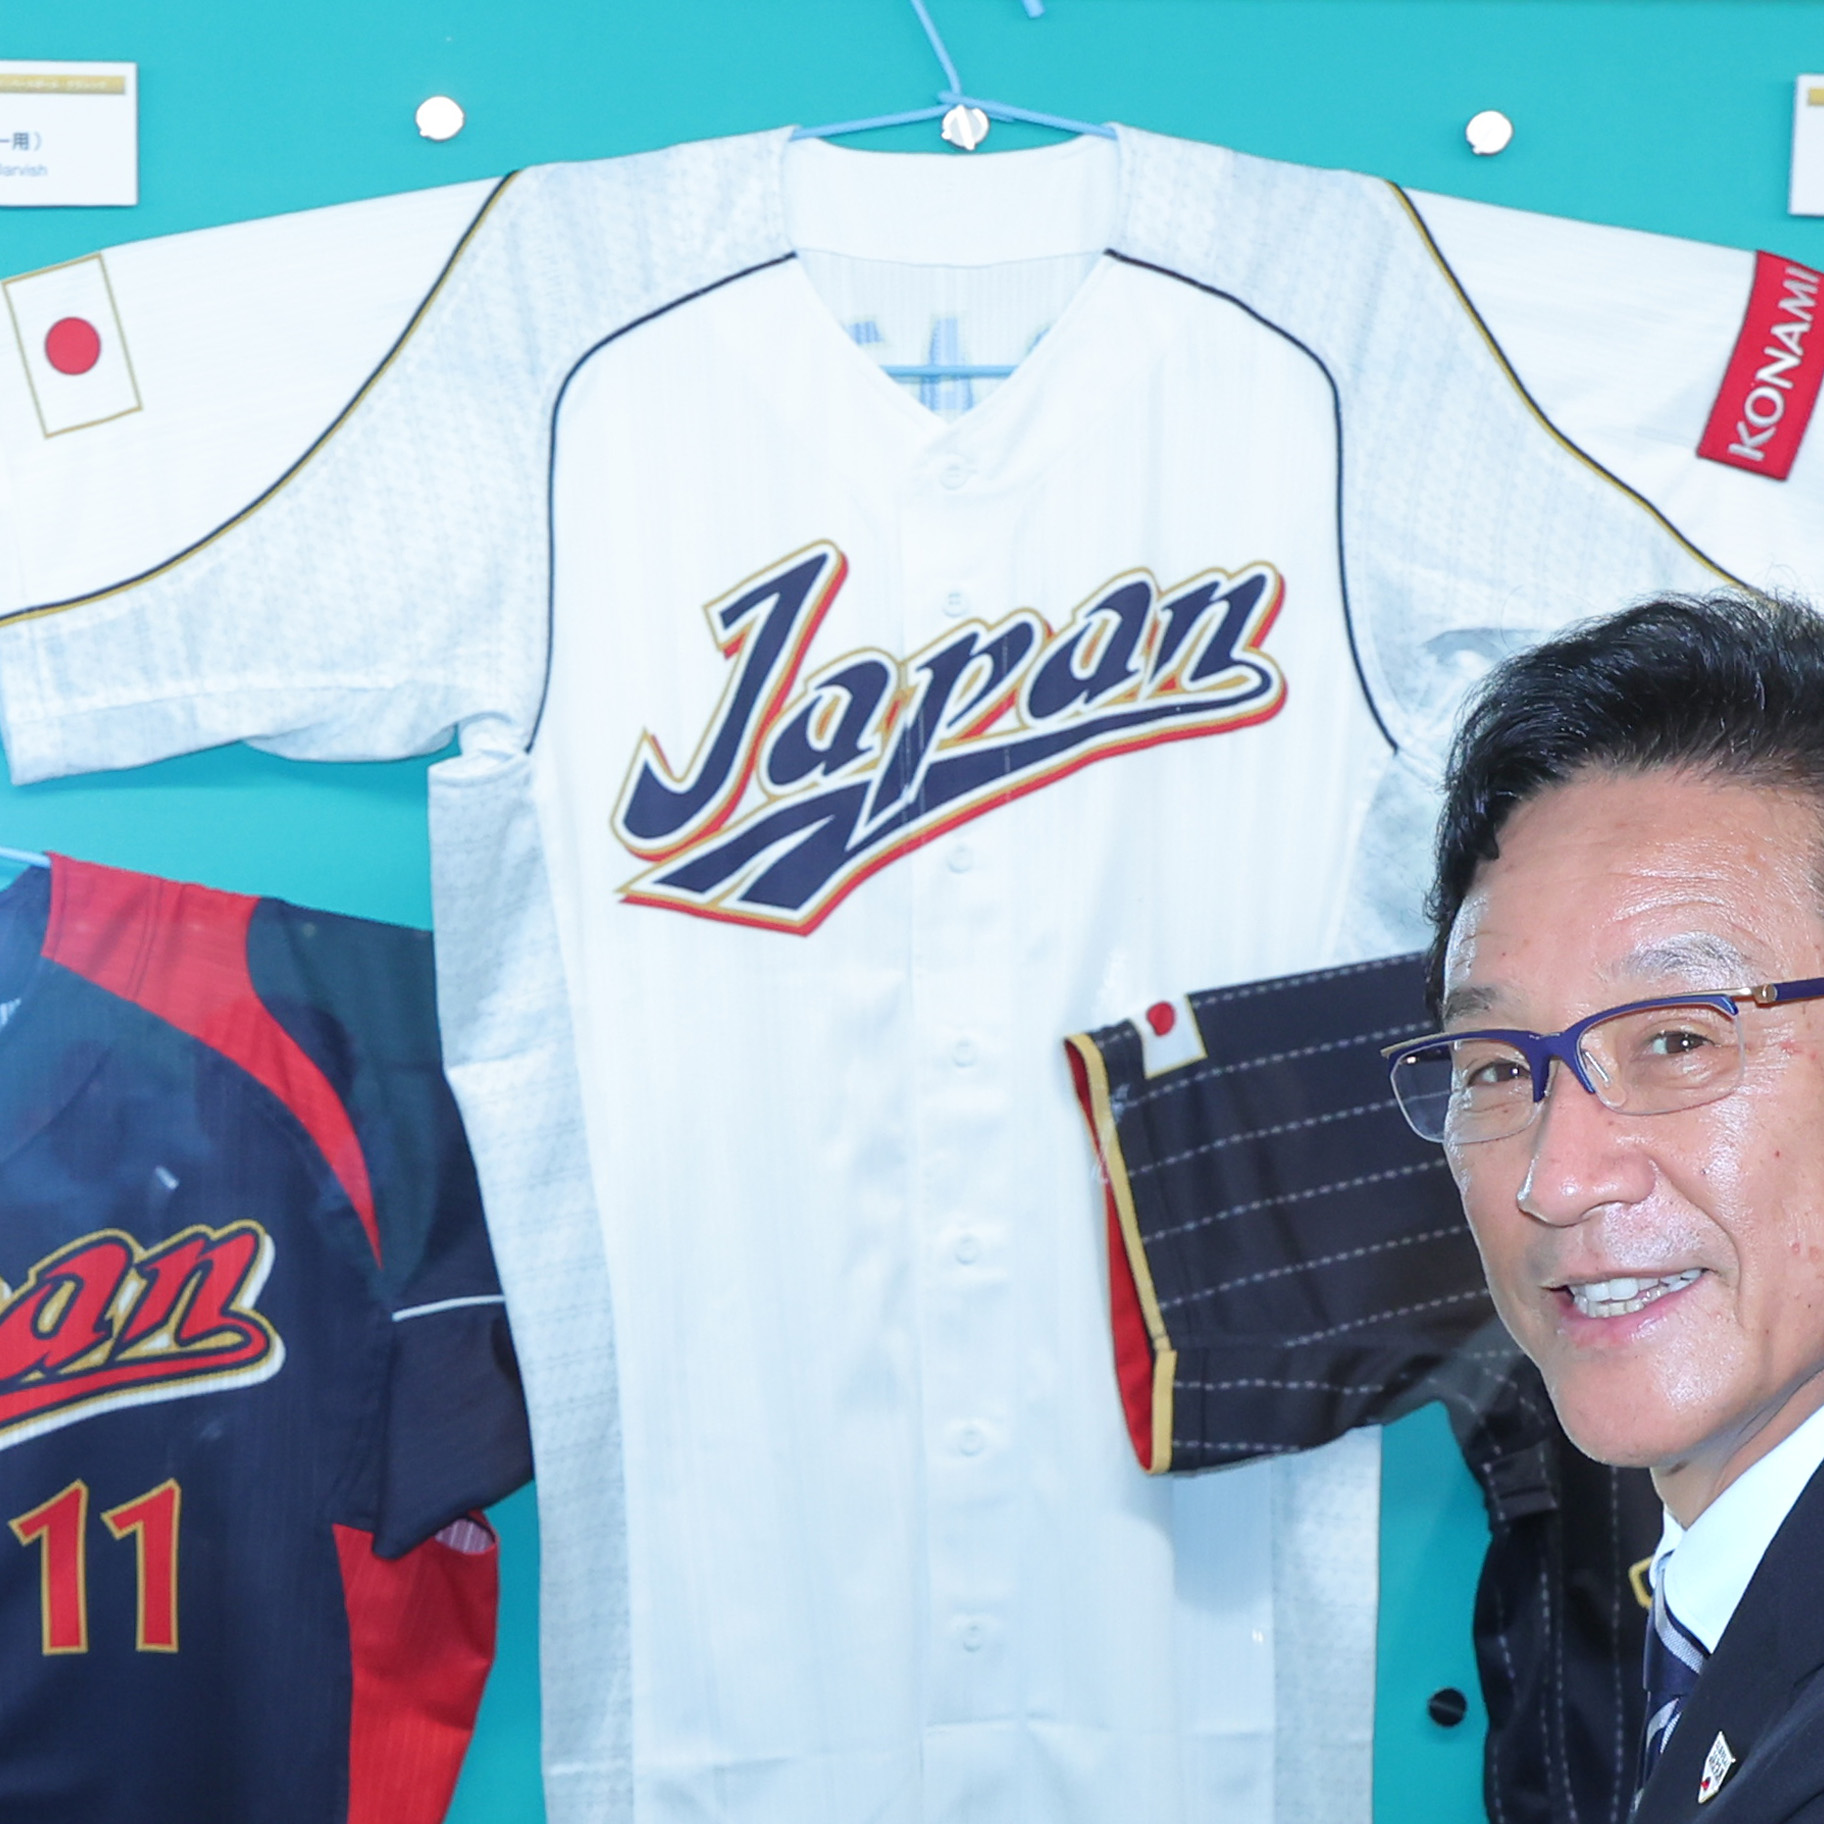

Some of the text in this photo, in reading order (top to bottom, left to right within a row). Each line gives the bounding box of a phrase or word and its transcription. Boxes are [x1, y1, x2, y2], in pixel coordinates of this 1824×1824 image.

[1728, 266, 1820, 462] KONAMI
[610, 539, 1287, 937] Japan
[8, 1477, 183, 1656] 11
